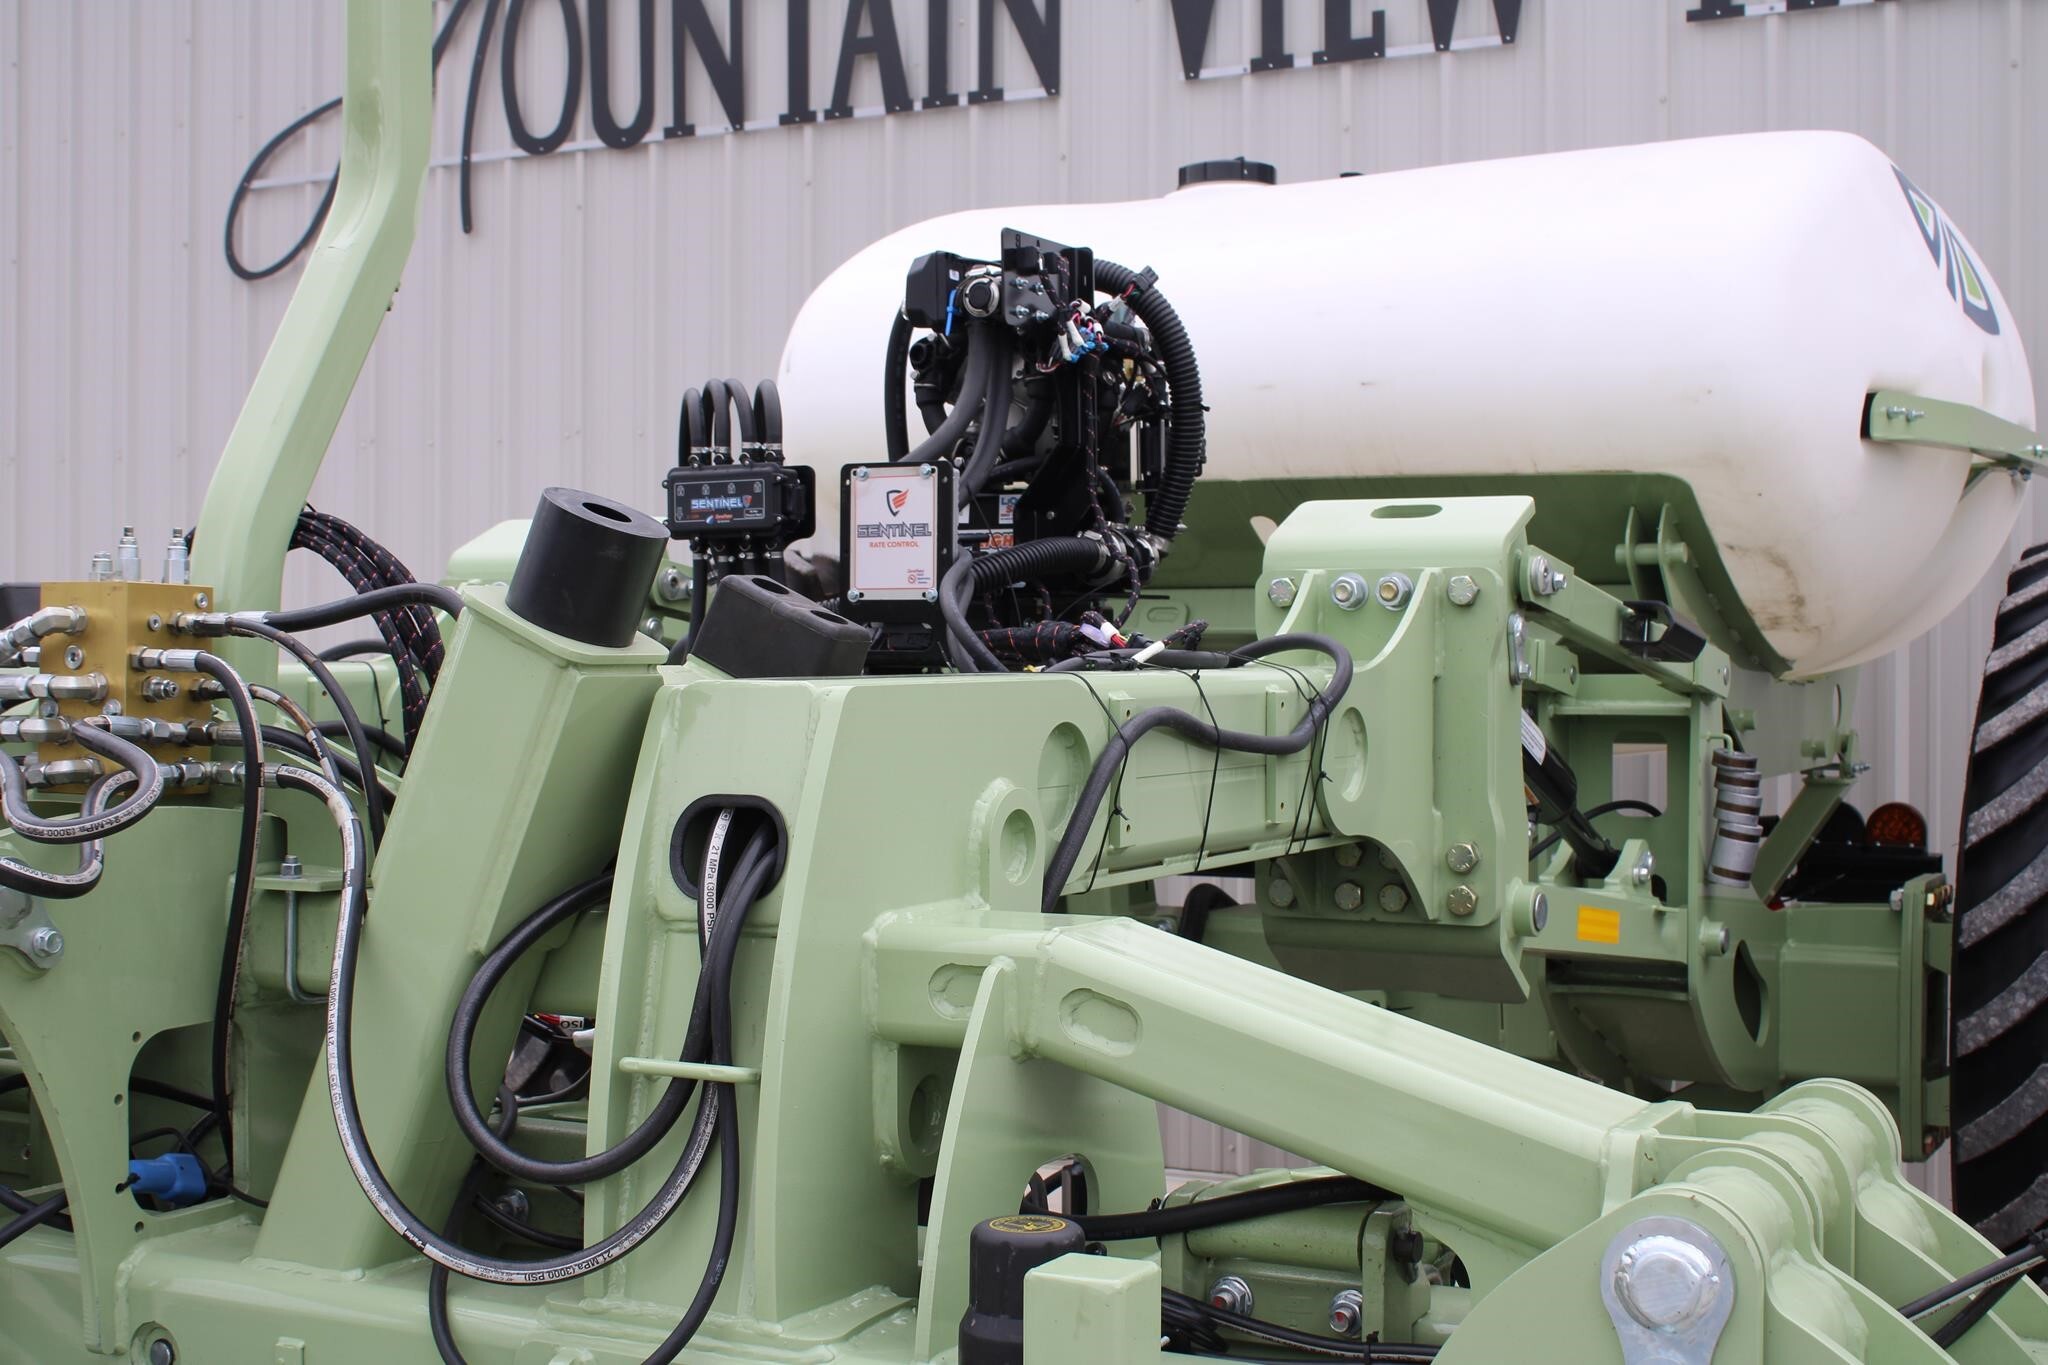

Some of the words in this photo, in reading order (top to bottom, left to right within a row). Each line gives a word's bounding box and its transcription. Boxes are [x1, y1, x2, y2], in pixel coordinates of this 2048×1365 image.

[690, 495, 743, 512] SENTINEL
[857, 522, 932, 539] SENTINEL
[869, 541, 886, 549] RATE
[887, 541, 919, 549] CONTROL
[707, 858, 718, 880] MPa
[706, 881, 716, 911] (3000
[577, 1256, 601, 1271] MPa
[524, 1272, 546, 1282] PSI)
[548, 1265, 576, 1280] (3000
